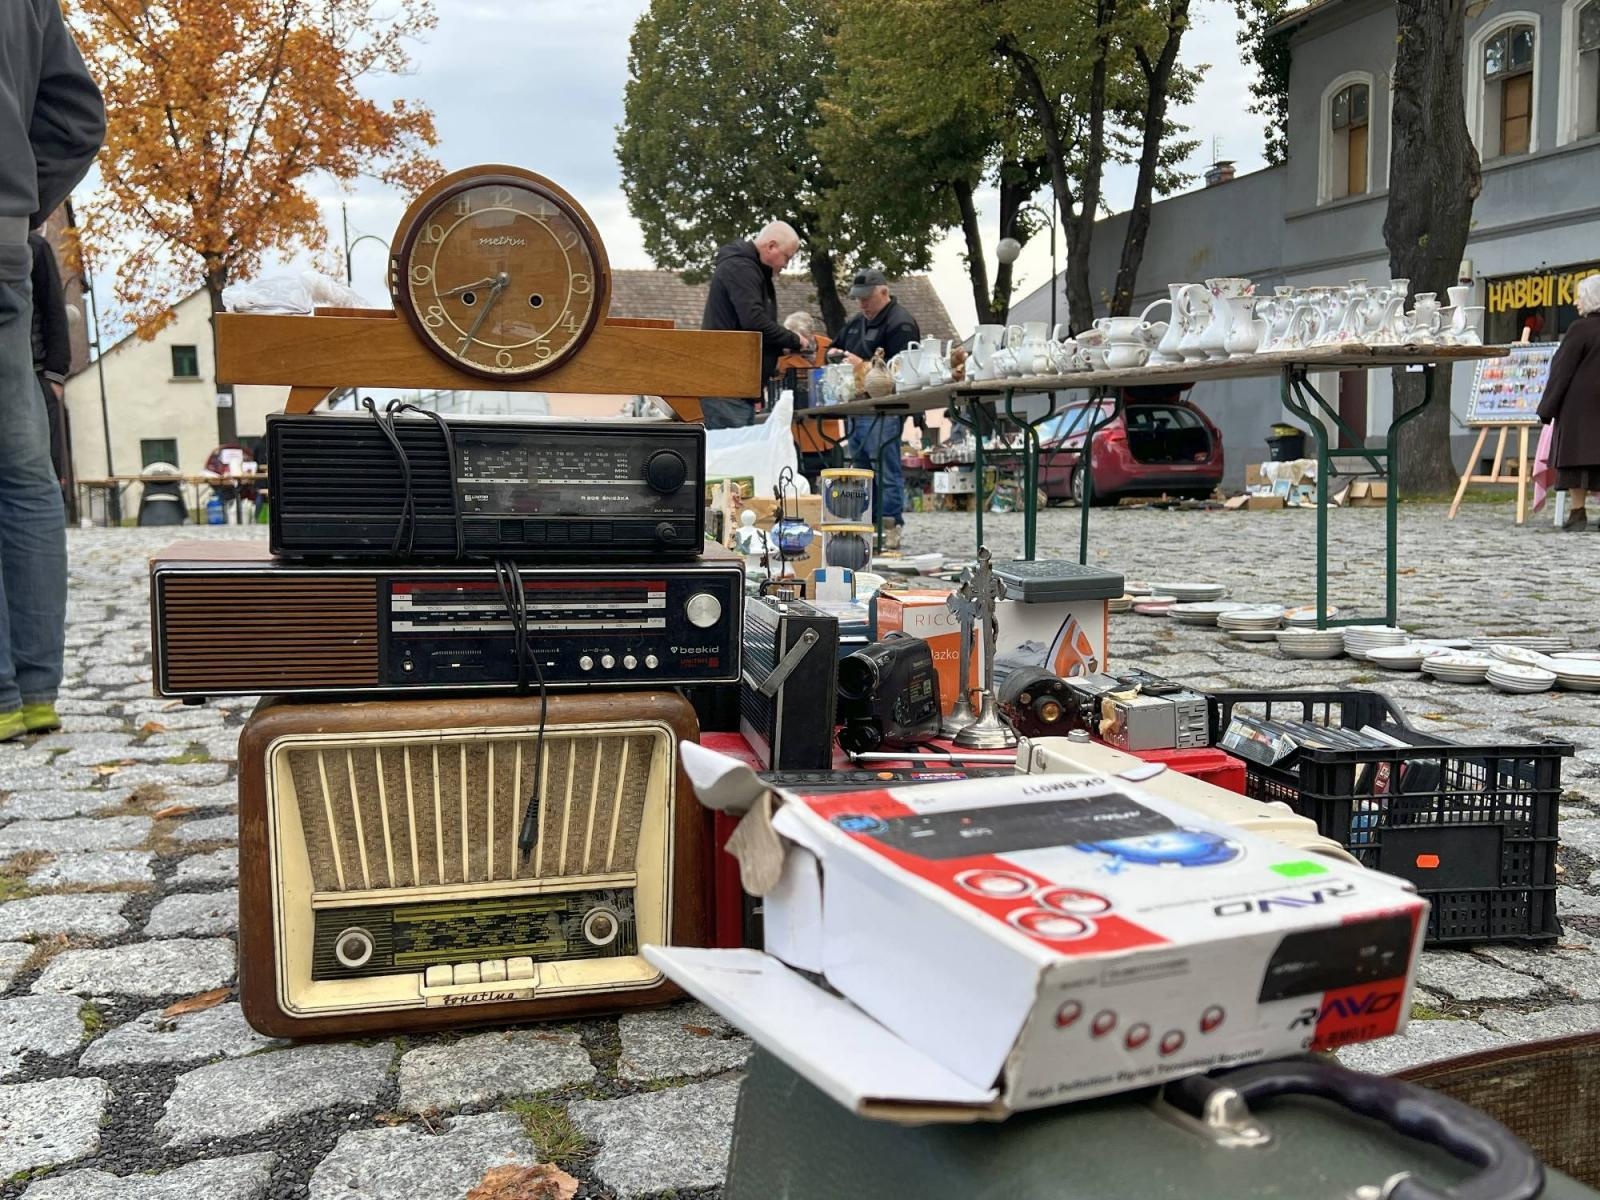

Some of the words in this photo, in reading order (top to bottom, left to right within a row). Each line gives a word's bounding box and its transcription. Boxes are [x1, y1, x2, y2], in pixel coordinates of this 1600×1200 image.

[455, 195, 471, 217] 11
[492, 189, 513, 207] 12
[421, 223, 445, 244] 10
[564, 231, 579, 251] 2
[411, 265, 433, 286] 9
[571, 272, 592, 295] 3
[424, 305, 444, 328] 8
[560, 310, 581, 334] 4
[495, 348, 513, 369] 6
[534, 339, 553, 360] 5
[914, 612, 957, 628] RICC
[679, 645, 719, 654] beskid
[930, 648, 960, 661] lazko
[1212, 882, 1357, 918] RAVO
[1287, 991, 1401, 1031] RAVO
